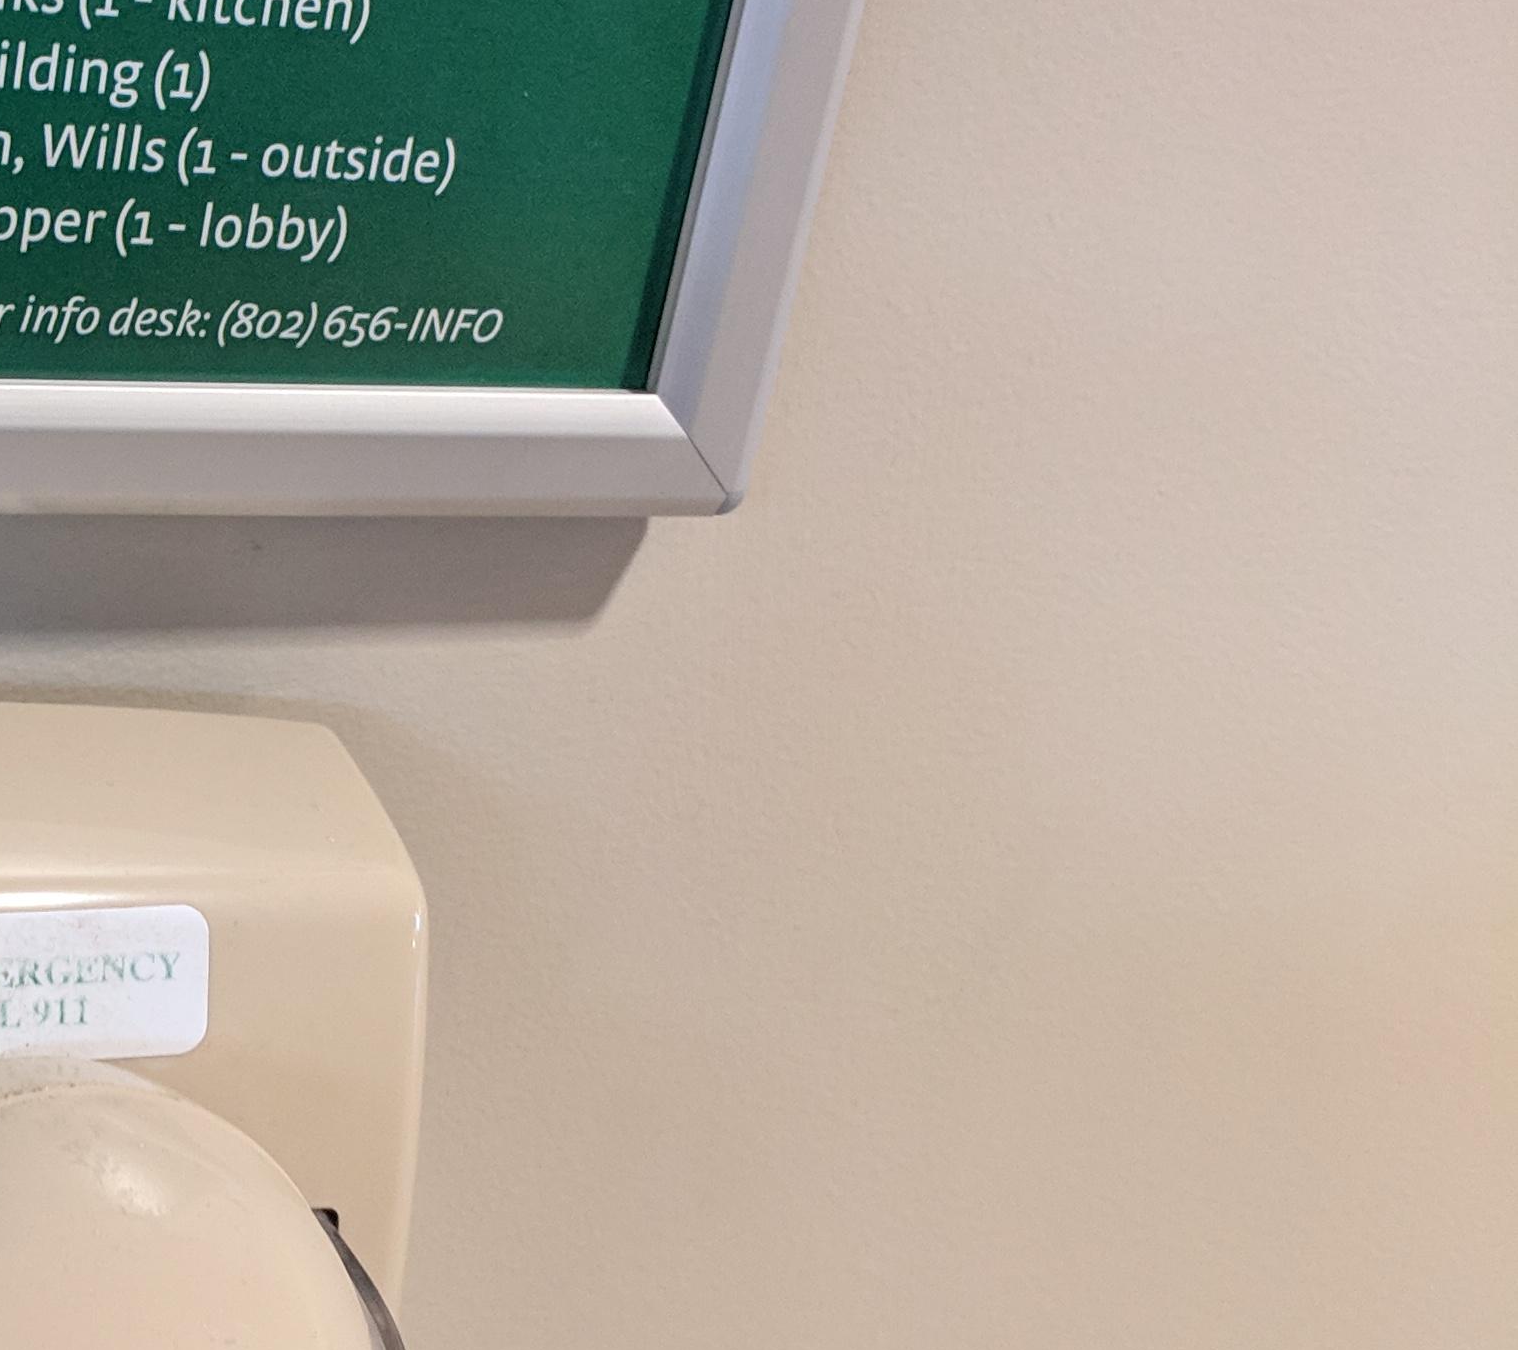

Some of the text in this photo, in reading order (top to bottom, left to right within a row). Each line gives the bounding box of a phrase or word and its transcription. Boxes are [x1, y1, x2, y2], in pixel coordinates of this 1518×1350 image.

[154, 48, 211, 112] (1)
[43, 123, 167, 173] Wills
[178, 126, 216, 186] (1
[261, 135, 456, 196] outside)
[115, 198, 154, 257] (1
[200, 201, 348, 263] lobby)
[20, 295, 101, 344] info
[108, 297, 211, 338] desk:
[217, 299, 318, 348] (802)
[323, 305, 504, 348] 656-INFO
[32, 994, 89, 1027] 911
